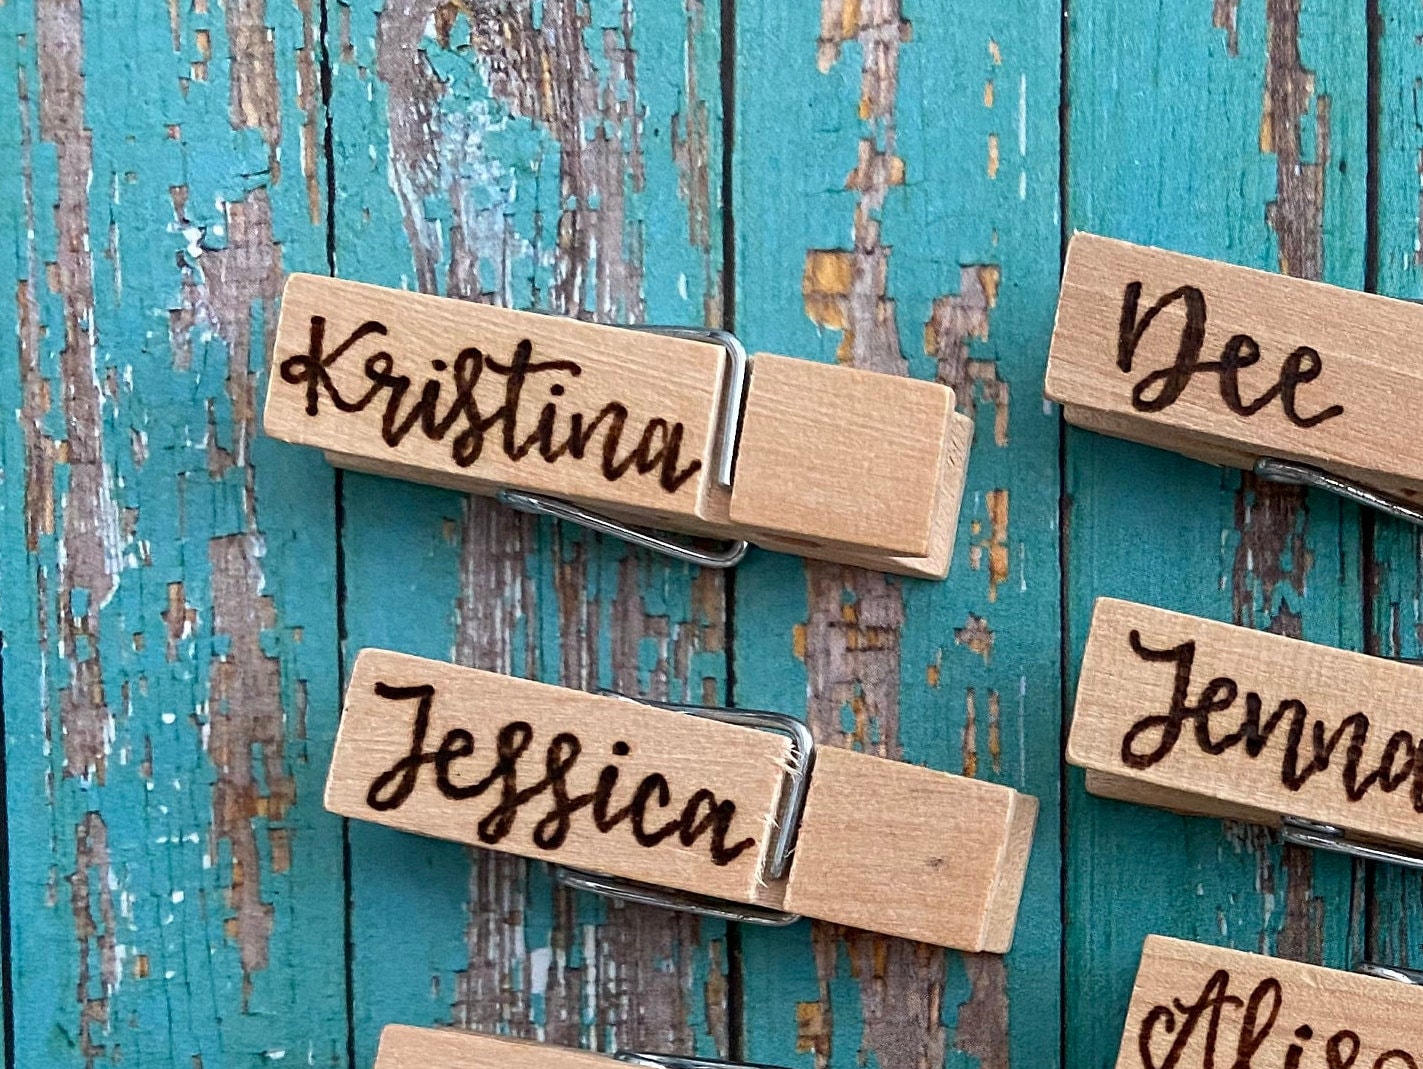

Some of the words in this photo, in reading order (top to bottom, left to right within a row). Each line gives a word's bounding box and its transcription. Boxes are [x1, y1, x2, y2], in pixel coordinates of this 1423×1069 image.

[280, 316, 701, 493] Kristina
[1116, 281, 1344, 428] Dee
[366, 682, 755, 866] Jessica
